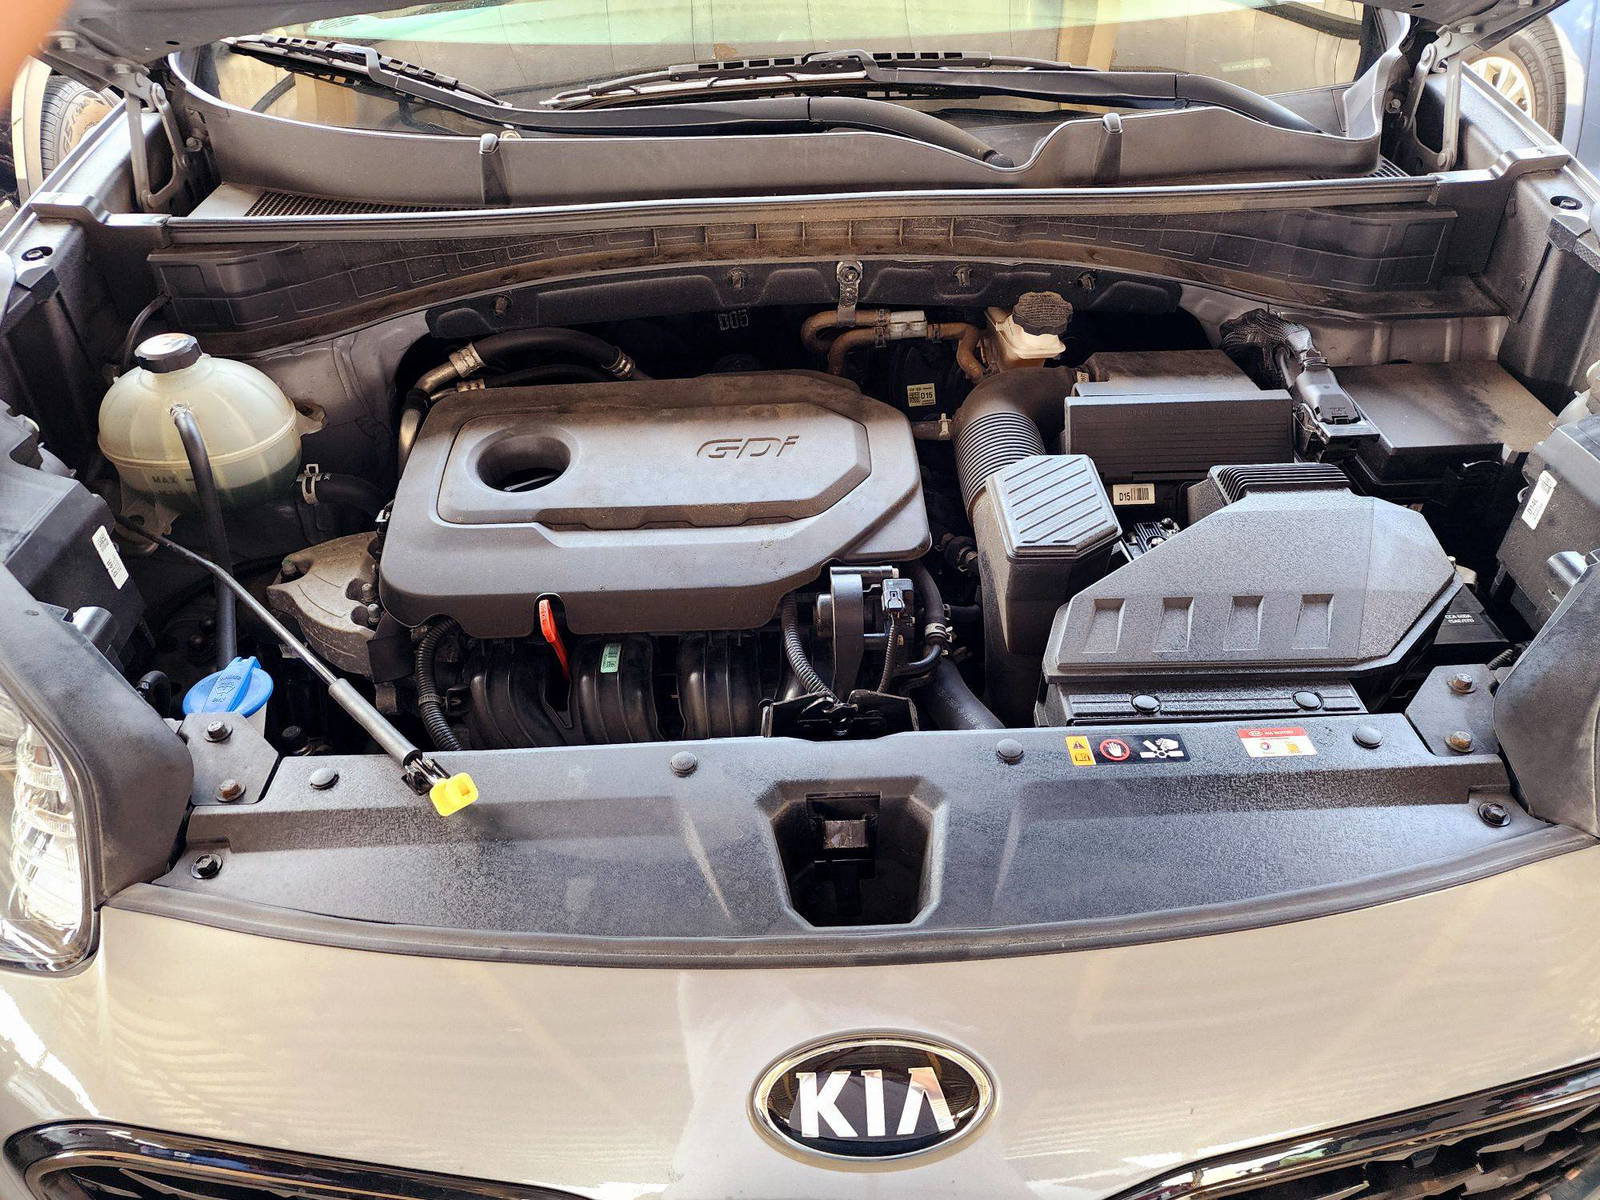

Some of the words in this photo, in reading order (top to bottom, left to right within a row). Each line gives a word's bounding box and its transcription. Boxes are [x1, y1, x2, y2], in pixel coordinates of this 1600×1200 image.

[920, 392, 933, 400] D15
[1119, 491, 1131, 502] D15
[796, 1067, 956, 1138] KIA
